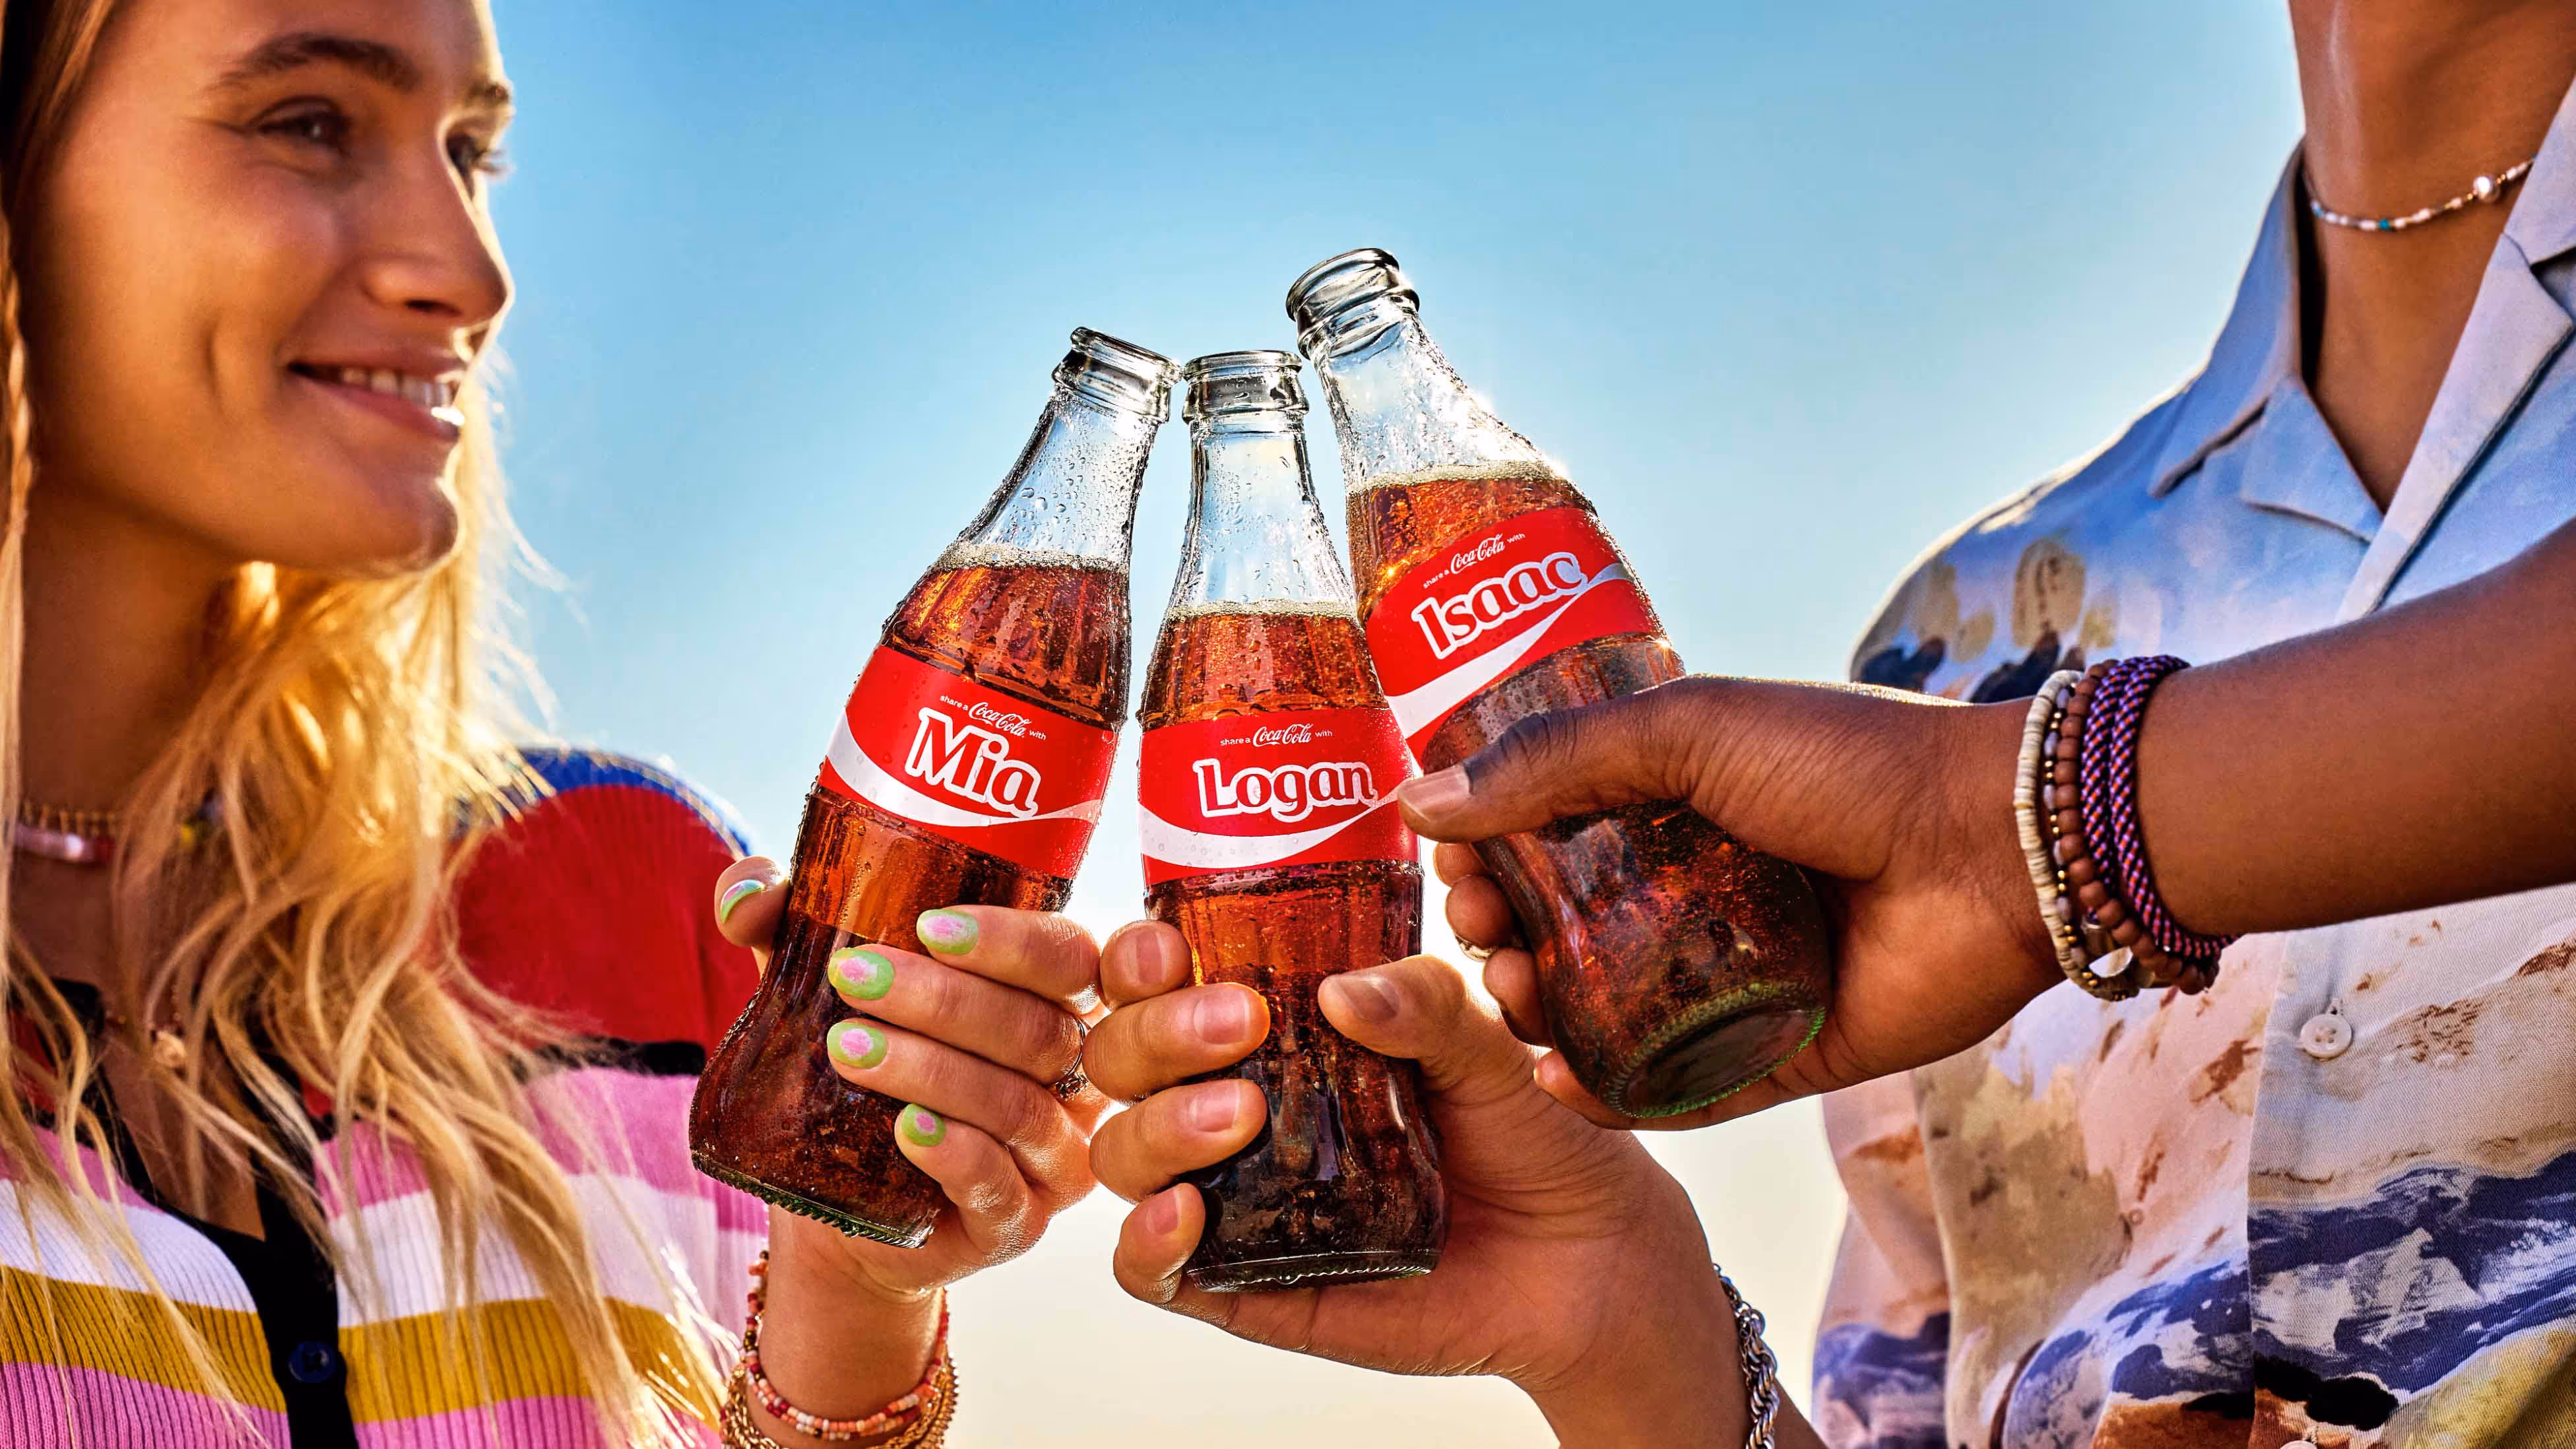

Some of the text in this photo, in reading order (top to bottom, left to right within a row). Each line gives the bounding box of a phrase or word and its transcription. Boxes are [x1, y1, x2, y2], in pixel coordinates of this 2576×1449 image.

[1423, 573, 1444, 589] share
[1450, 533, 1505, 574] Coca-Cola
[1506, 533, 1526, 543] with
[1411, 552, 1588, 659] Isaac
[940, 695, 962, 708] share
[969, 702, 1032, 738] Coca-Cola
[1029, 729, 1046, 740] with
[1220, 737, 1244, 746] share
[1253, 723, 1314, 747] Coca-Cola
[905, 707, 1041, 818] Mia
[1193, 758, 1378, 822] Logan
